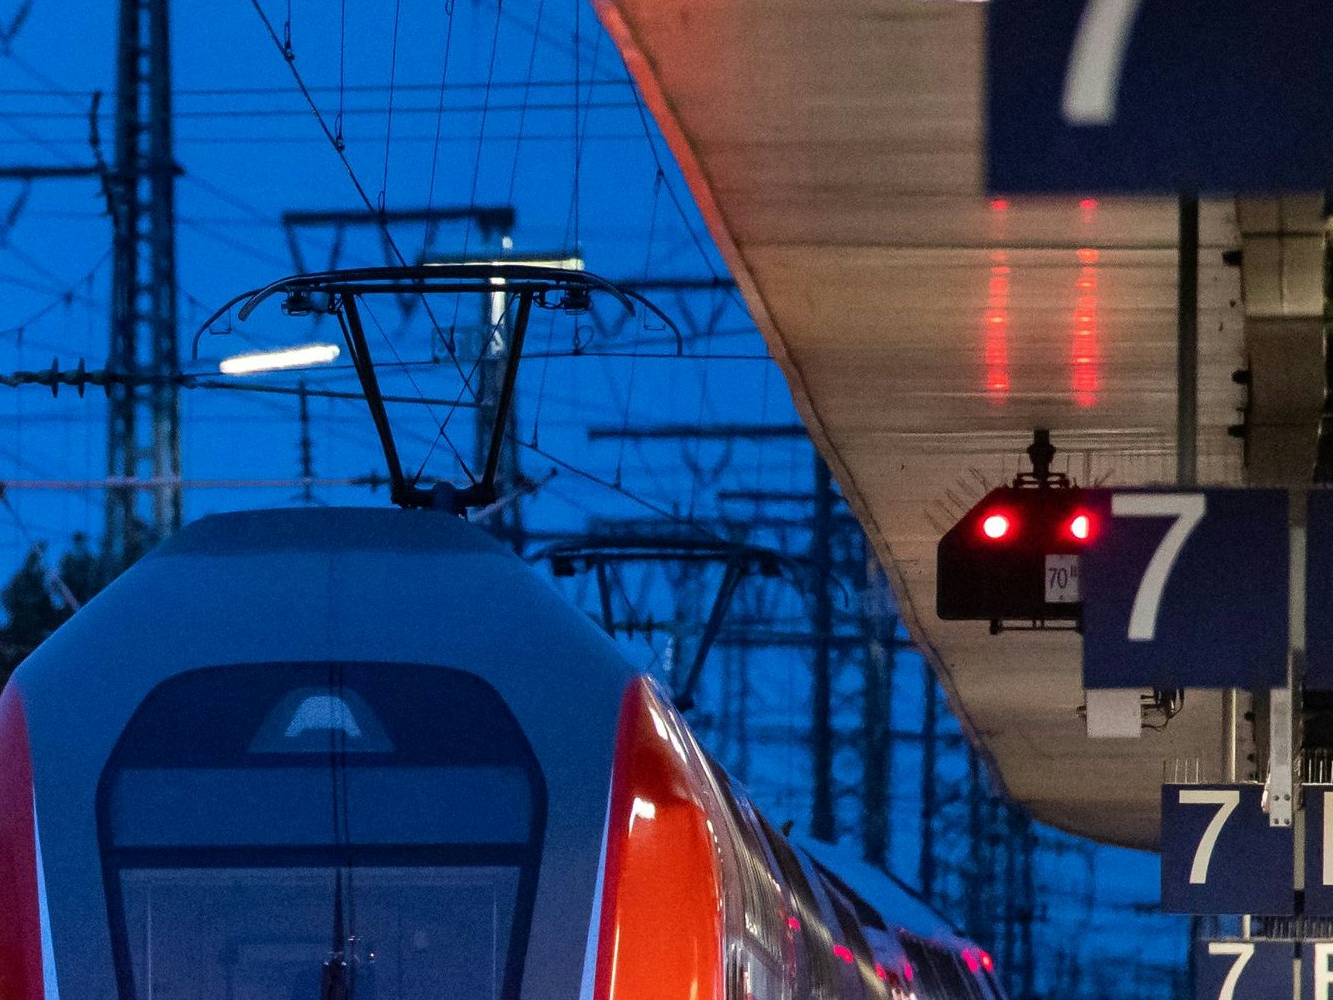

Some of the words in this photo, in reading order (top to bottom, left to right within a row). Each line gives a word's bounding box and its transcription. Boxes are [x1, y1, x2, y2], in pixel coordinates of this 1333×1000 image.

[1048, 568, 1068, 589] 70
[1111, 493, 1206, 641] 7
[1178, 790, 1240, 884] 7
